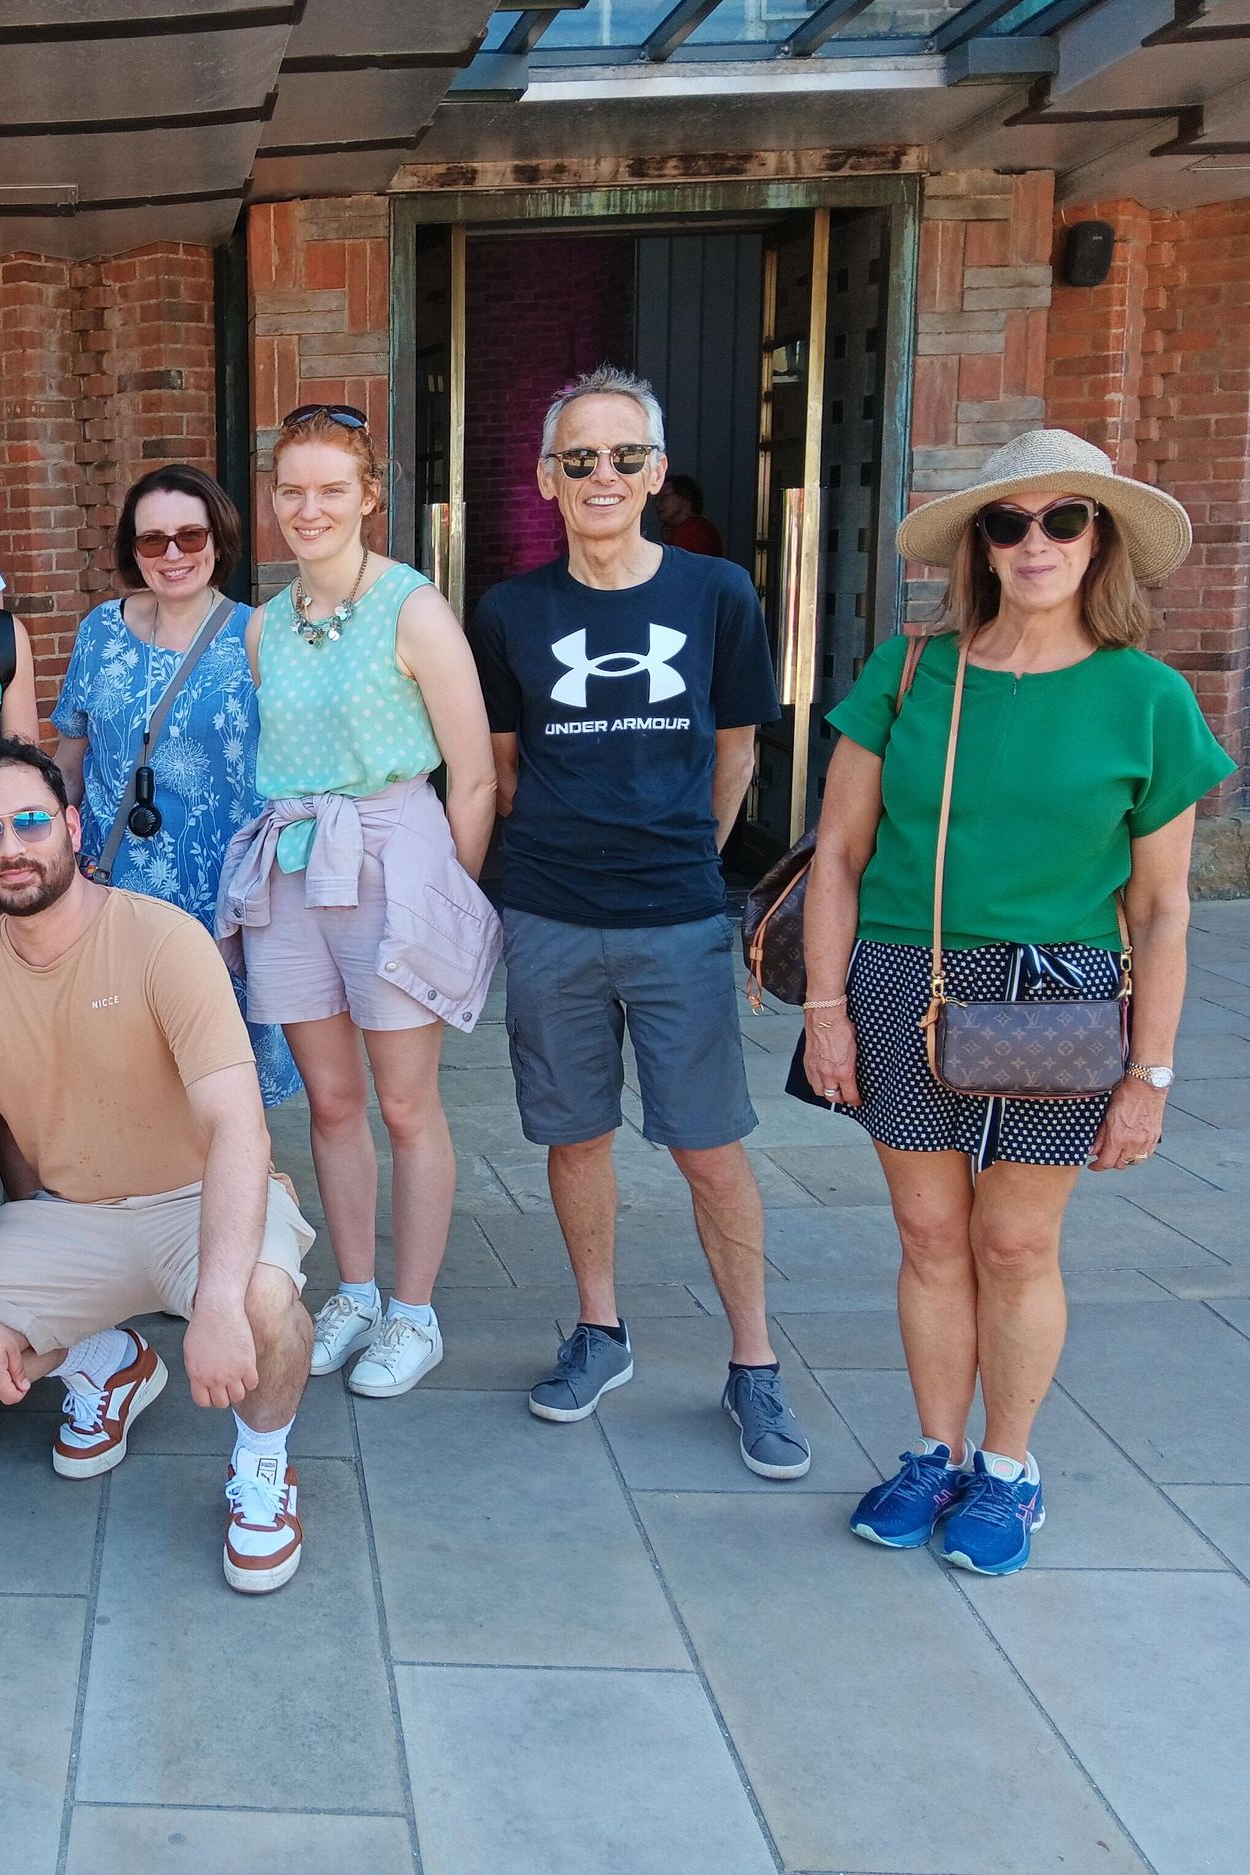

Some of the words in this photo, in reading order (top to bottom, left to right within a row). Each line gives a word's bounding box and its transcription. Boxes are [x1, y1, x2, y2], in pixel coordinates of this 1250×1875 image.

[545, 720, 608, 735] UNDER
[611, 717, 690, 732] ARMOUR
[92, 995, 119, 1009] NICCE
